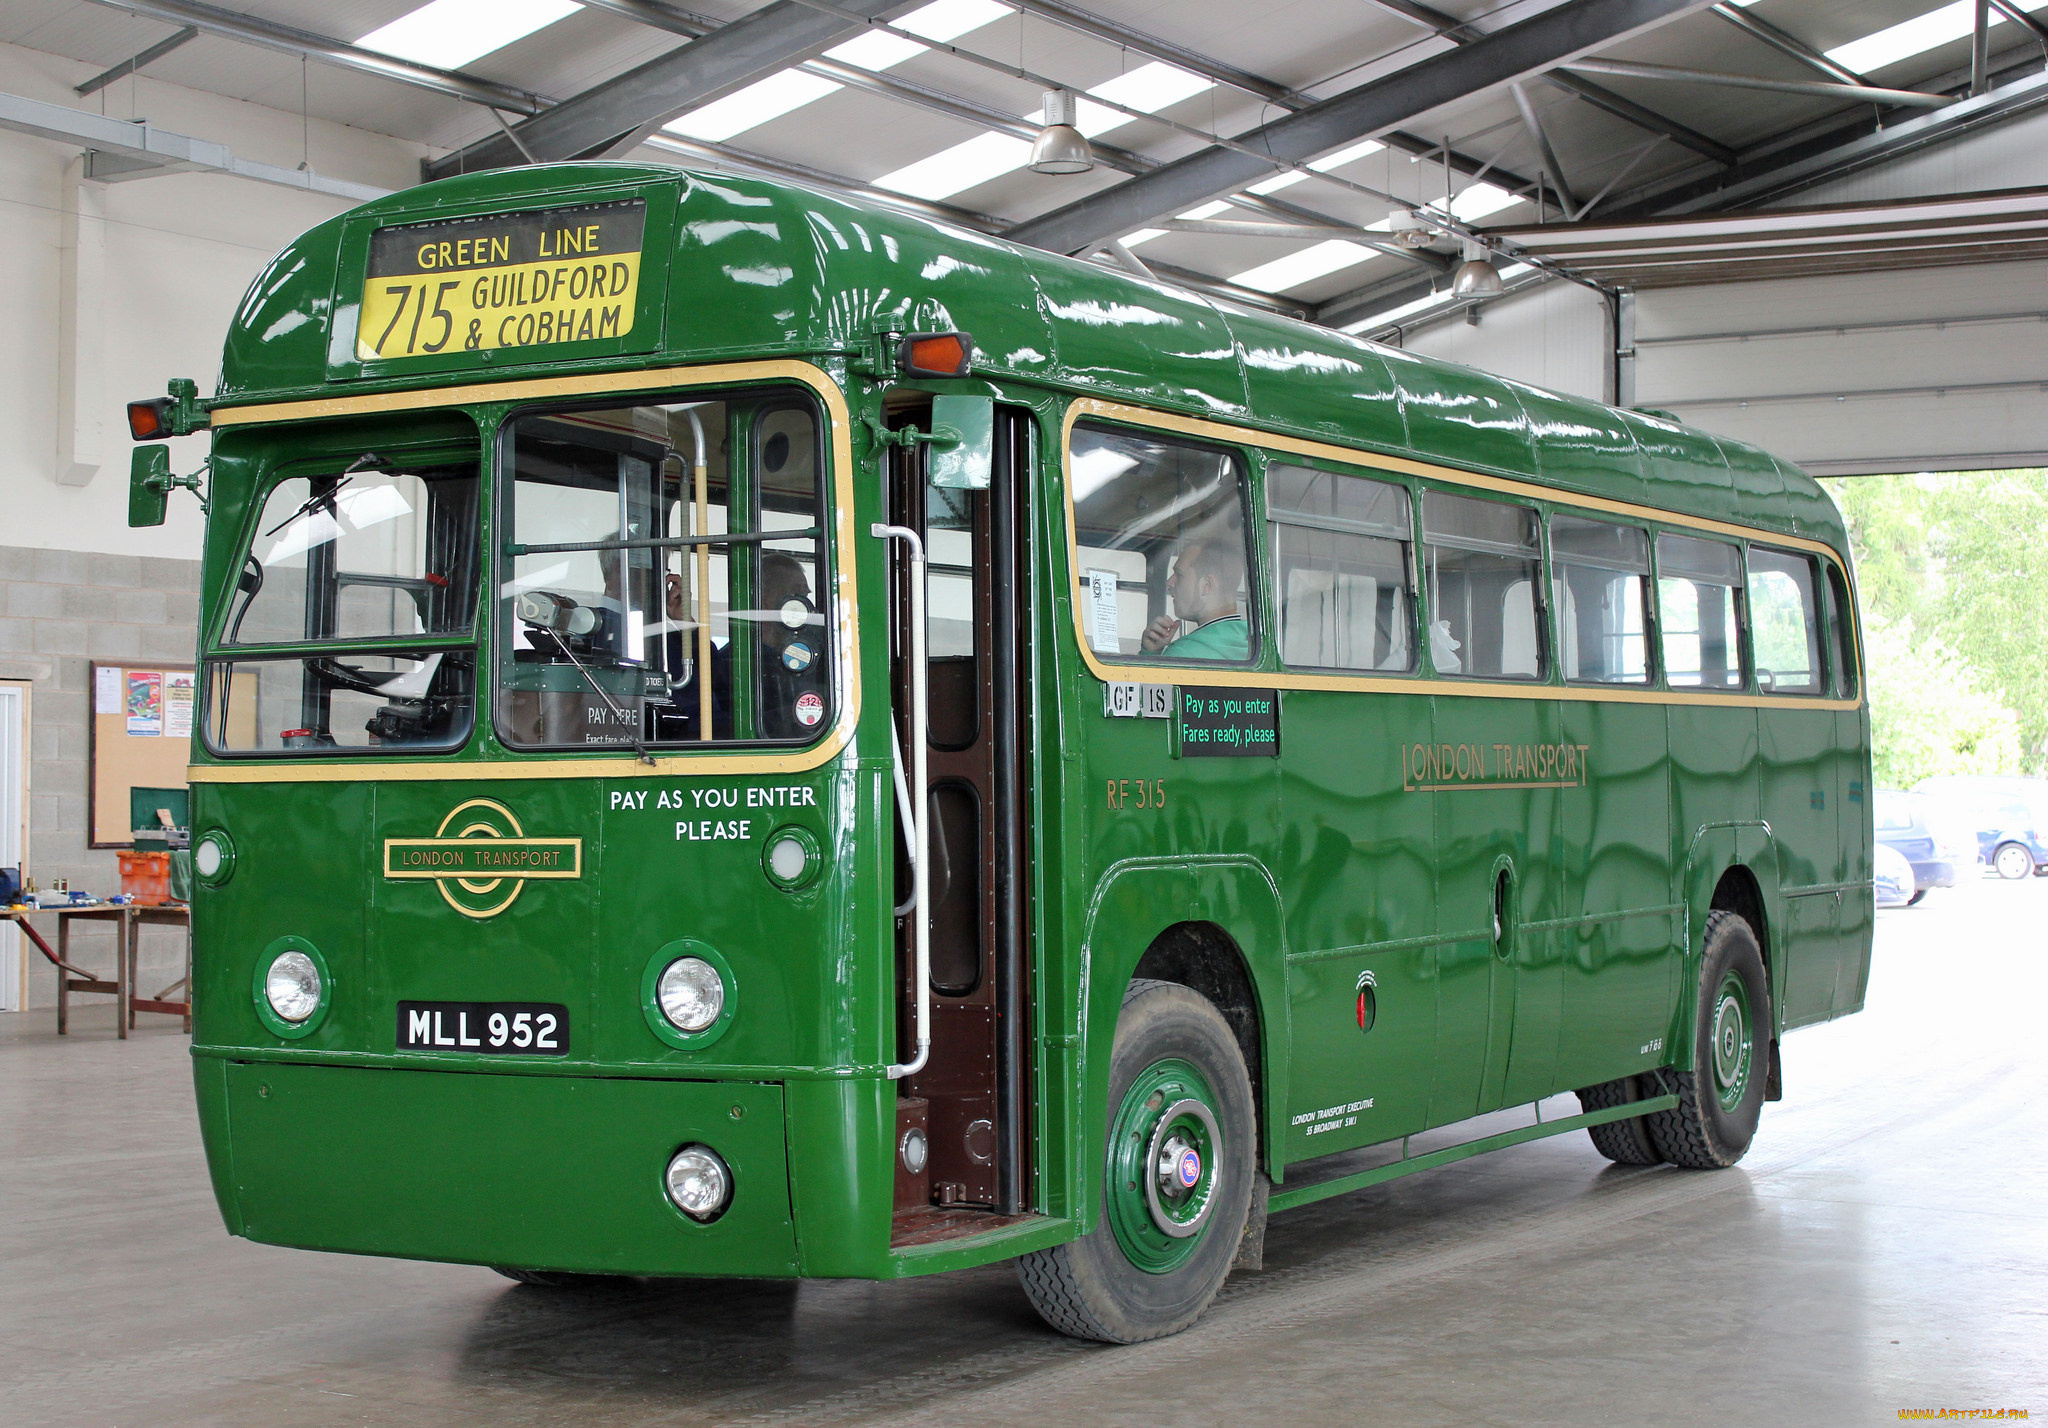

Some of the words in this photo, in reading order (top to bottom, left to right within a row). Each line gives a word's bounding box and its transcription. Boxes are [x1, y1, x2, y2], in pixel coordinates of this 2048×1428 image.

[417, 236, 510, 269] GREEN
[538, 225, 600, 257] LINE
[472, 262, 630, 309] GUILDFORD
[376, 280, 461, 355] 715
[465, 318, 483, 350] &
[498, 304, 622, 348] COBHAM
[1114, 686, 1135, 711] GF
[1185, 694, 1204, 718] Pay
[1208, 699, 1219, 714] as
[1223, 699, 1242, 718] you
[1245, 699, 1270, 714] enter
[588, 707, 608, 724] PAY
[586, 733, 603, 743] Exact
[1183, 723, 1210, 743] Fares
[1213, 724, 1243, 747] ready,
[1245, 724, 1275, 748] please
[1402, 743, 1485, 792] LONDON
[1492, 743, 1589, 787] TRANSPORT
[610, 790, 648, 810] PAY
[656, 790, 683, 810] AS
[690, 788, 738, 808] YOU
[746, 786, 816, 808] ENTER
[1107, 779, 1129, 810] RF
[1135, 778, 1165, 809] 315
[675, 820, 751, 841] PLEASE
[403, 851, 464, 866] LONDON
[474, 851, 560, 866] TRANSPORT
[408, 1009, 481, 1046] MLL
[488, 1012, 558, 1048] 952
[1291, 1111, 1316, 1125] LONDON
[1316, 1104, 1347, 1120] TRANSPORT
[1347, 1097, 1374, 1113] EXECUTIVE
[1313, 1119, 1344, 1134] BROADWAY
